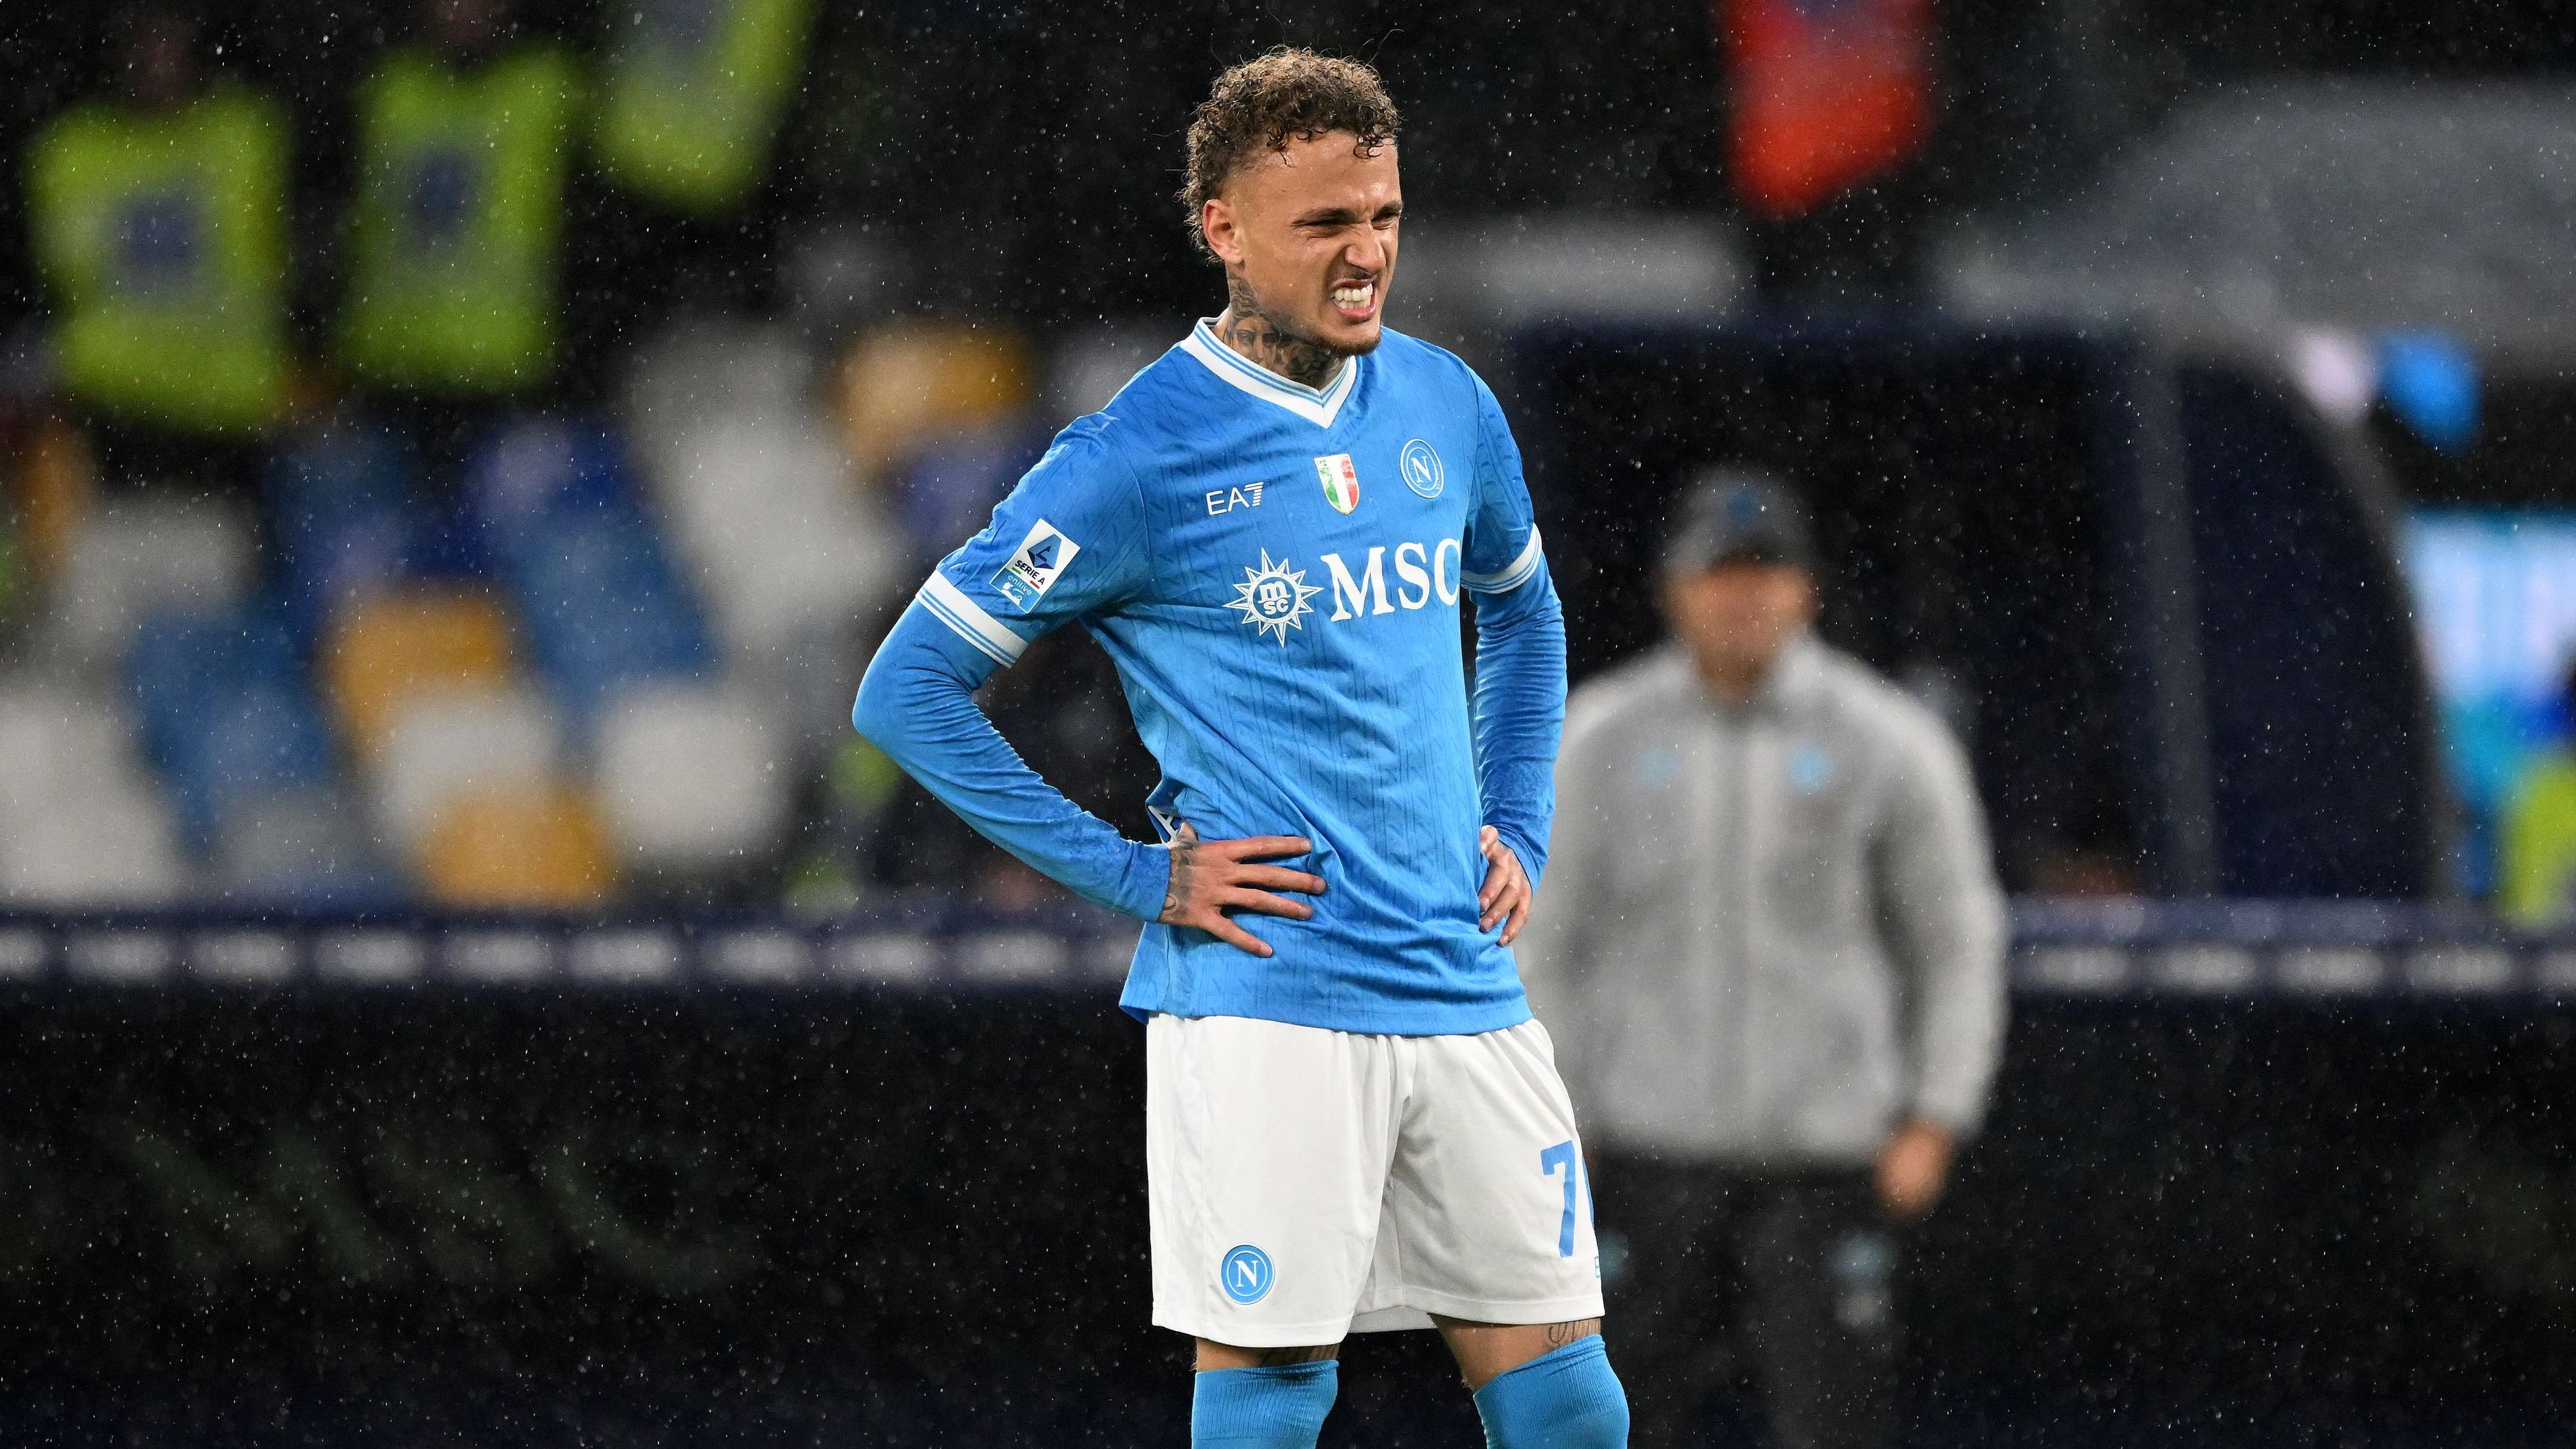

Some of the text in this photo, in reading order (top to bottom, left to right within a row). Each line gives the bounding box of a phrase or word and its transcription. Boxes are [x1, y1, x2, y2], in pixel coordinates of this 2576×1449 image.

[1410, 456, 1432, 483] N
[1206, 482, 1264, 515] EA7
[1008, 575, 1032, 595] enilive
[1014, 560, 1045, 585] SERIE A
[1320, 538, 1461, 622] MSC
[1540, 1139, 1594, 1259] 7
[1235, 1260, 1259, 1288] N
